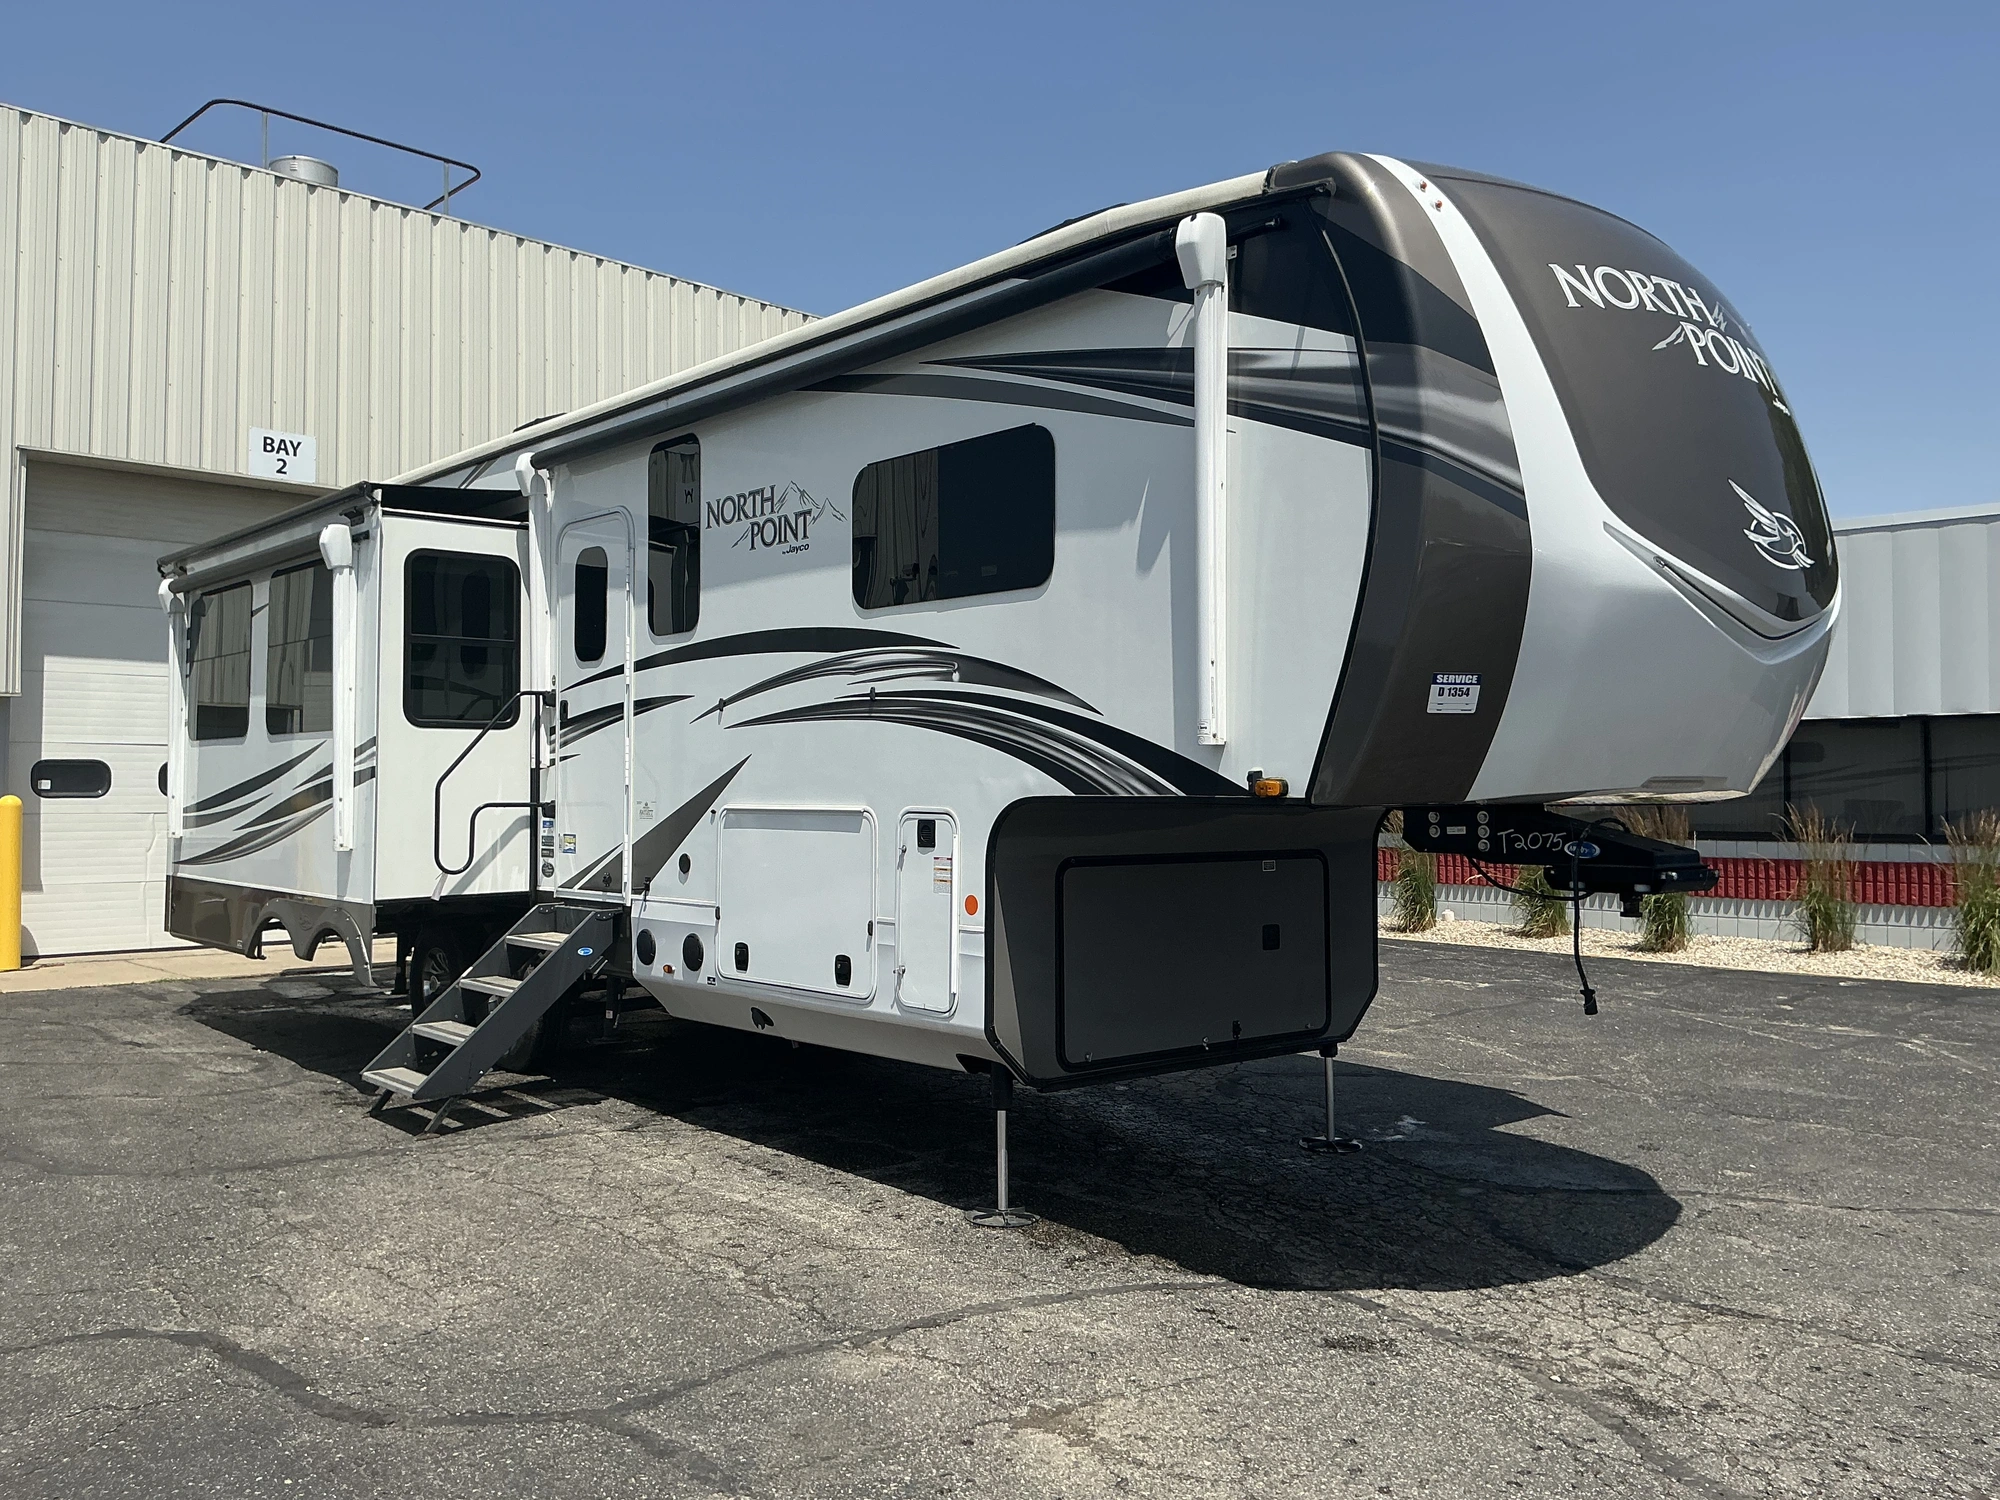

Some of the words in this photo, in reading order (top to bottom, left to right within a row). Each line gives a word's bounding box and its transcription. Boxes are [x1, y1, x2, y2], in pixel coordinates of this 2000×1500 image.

[1548, 263, 1718, 327] NORTH
[1679, 321, 1778, 397] POINT
[263, 436, 302, 457] BAY
[276, 458, 287, 475] 2
[705, 485, 776, 529] NORTH
[749, 508, 812, 551] POINT
[786, 544, 810, 555] Jayco
[1436, 674, 1478, 684] SERVICE
[1437, 687, 1445, 697] D
[1447, 687, 1470, 697] 1354
[1497, 829, 1567, 854] T2075
